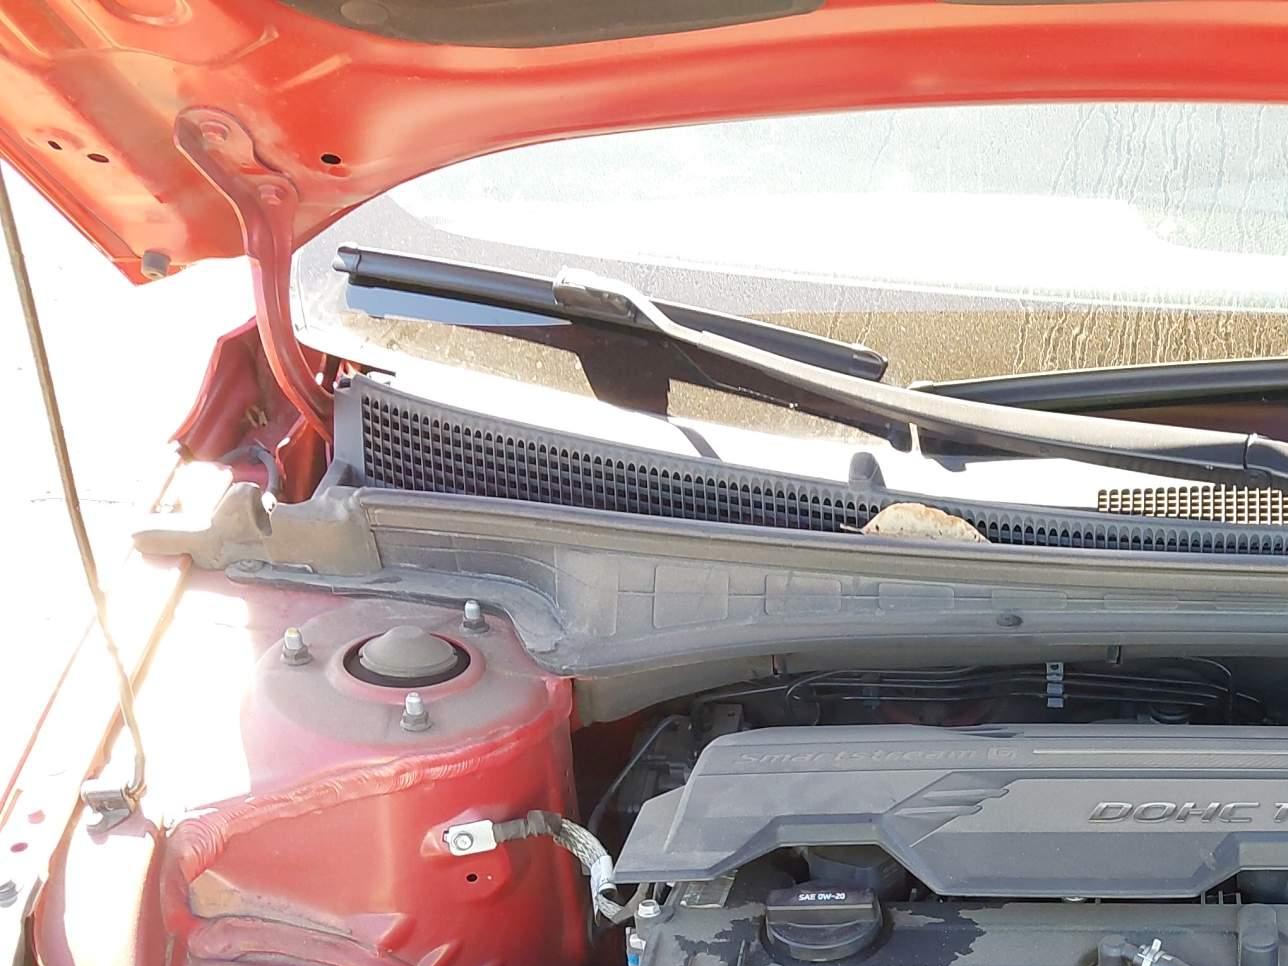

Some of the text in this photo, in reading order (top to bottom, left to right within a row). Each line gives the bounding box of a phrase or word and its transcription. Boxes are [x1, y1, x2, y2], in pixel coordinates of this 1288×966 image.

[735, 749, 977, 765] Smartstream
[1088, 802, 1260, 823] DOHC
[798, 892, 846, 901] SAE 0W-20
